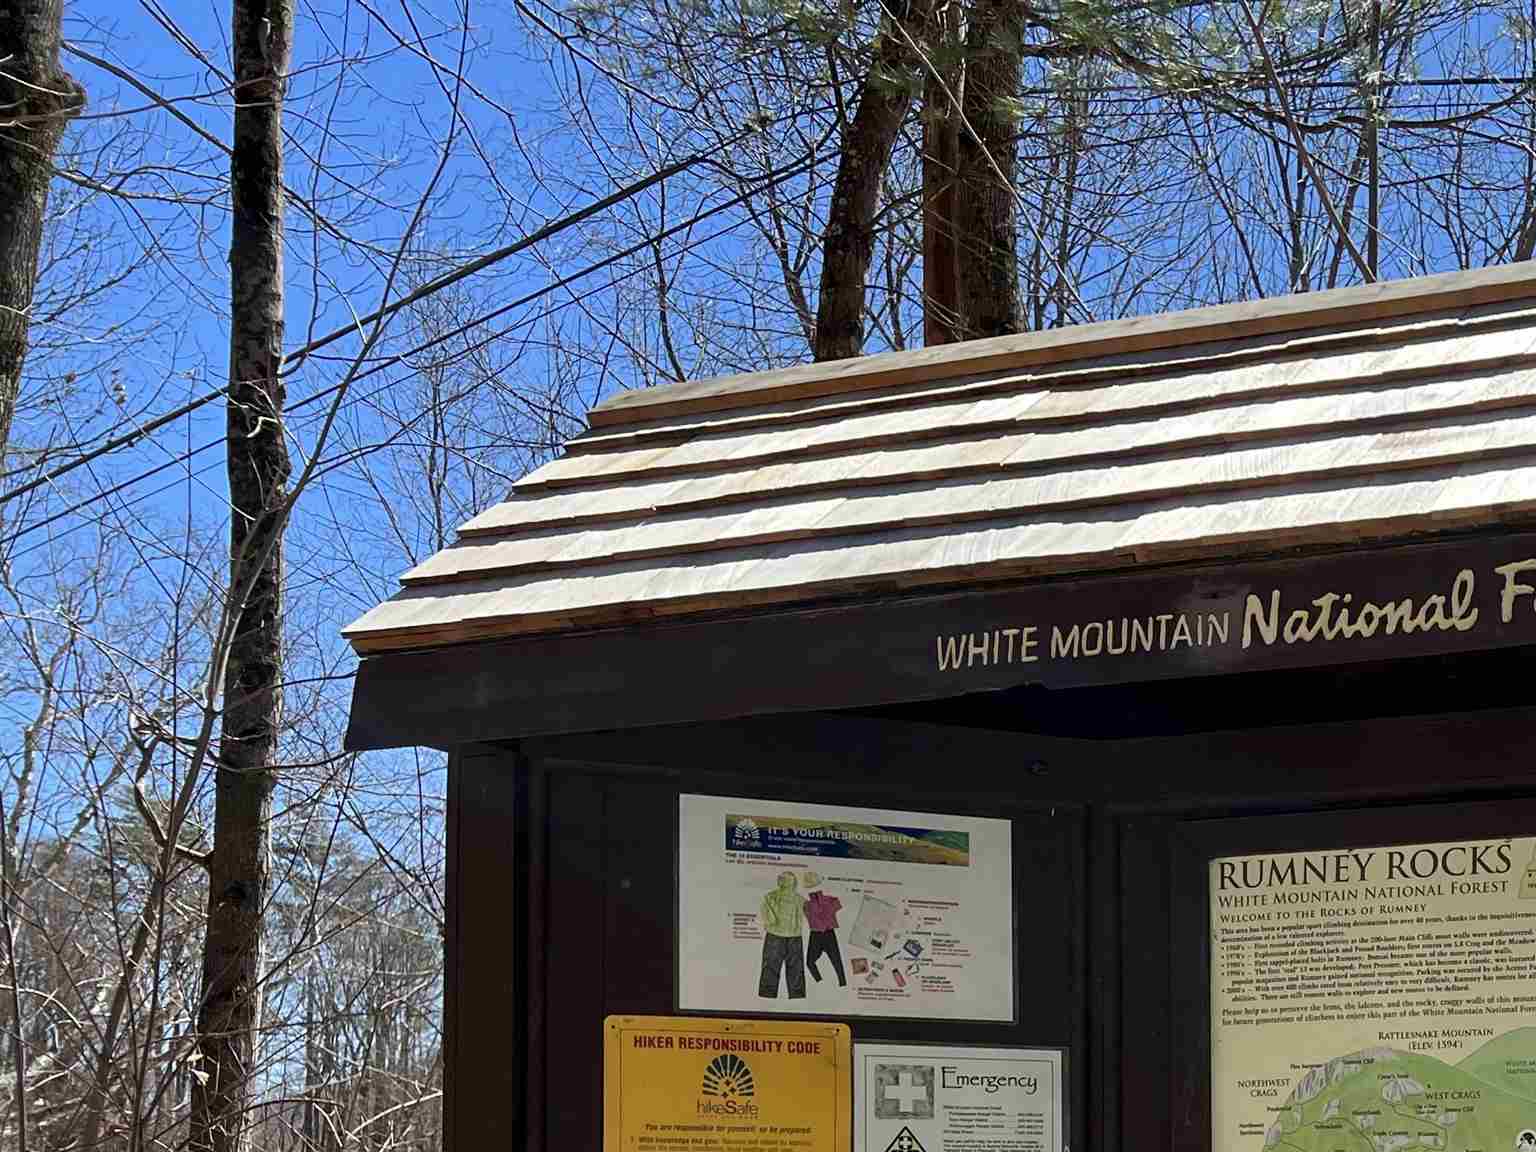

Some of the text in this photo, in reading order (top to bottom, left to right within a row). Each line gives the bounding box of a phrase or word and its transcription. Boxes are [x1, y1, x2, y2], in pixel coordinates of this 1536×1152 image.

[936, 627, 1039, 671] WHITE
[1048, 611, 1230, 658] MOUNTAIN
[1241, 570, 1479, 648] National
[768, 826, 915, 845] IT'S YOUR RESPONSIBILITY
[1218, 844, 1511, 890] RUMNEY ROCKS
[1218, 880, 1509, 909] WHITE MOUNTAIN NATIONAL FOREST
[1219, 903, 1426, 924] WELCOME TO THE ROCKS OF RUMNEY
[633, 1034, 821, 1055] HIKER RESPONSIBILITY CODE
[1378, 1027, 1494, 1042] RATTLESNAKE MOUNTAIN
[941, 1066, 1038, 1095] Emergency
[1237, 1078, 1291, 1089] NORTHWEST
[1249, 1087, 1278, 1098] CRAGS
[1425, 1089, 1481, 1101] WEST CRAGS
[696, 1099, 760, 1116] hikeSafe
